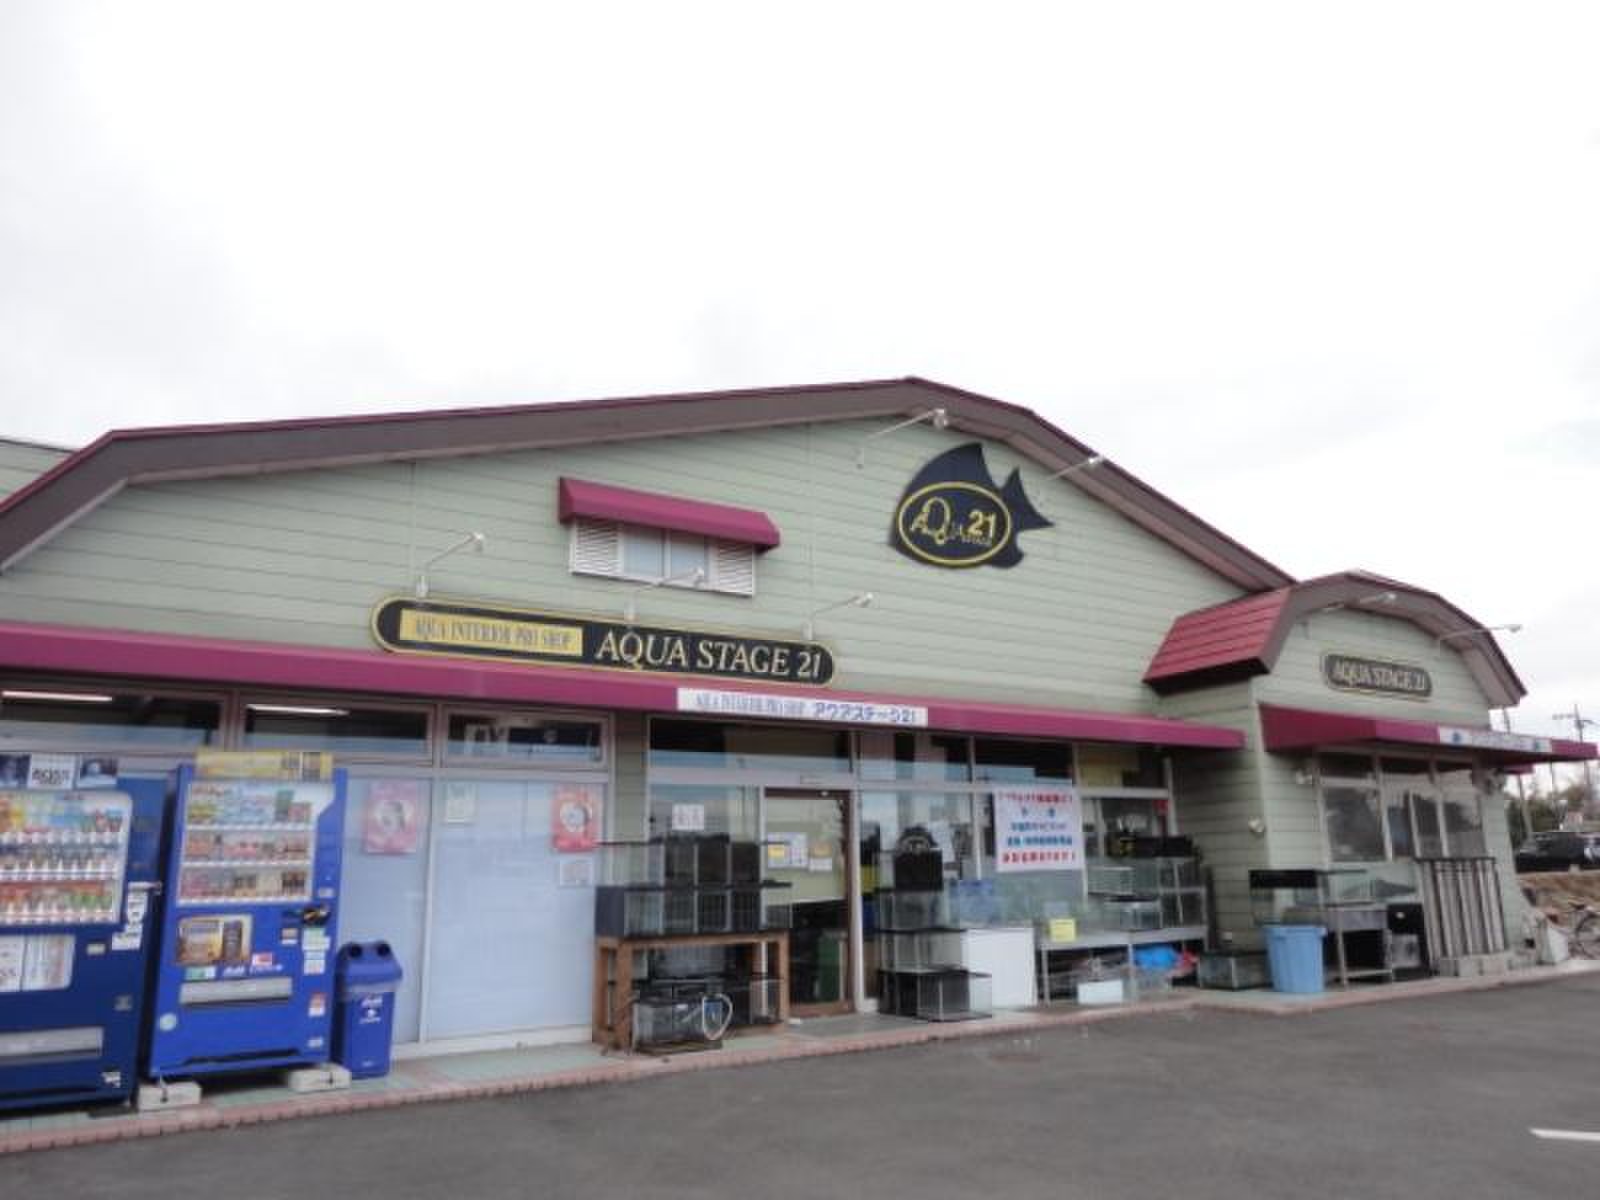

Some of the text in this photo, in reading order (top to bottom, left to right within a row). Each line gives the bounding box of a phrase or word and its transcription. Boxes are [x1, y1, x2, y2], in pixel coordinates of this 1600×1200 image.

[966, 510, 996, 540] 21
[594, 630, 822, 678] AQUA STAGE 21
